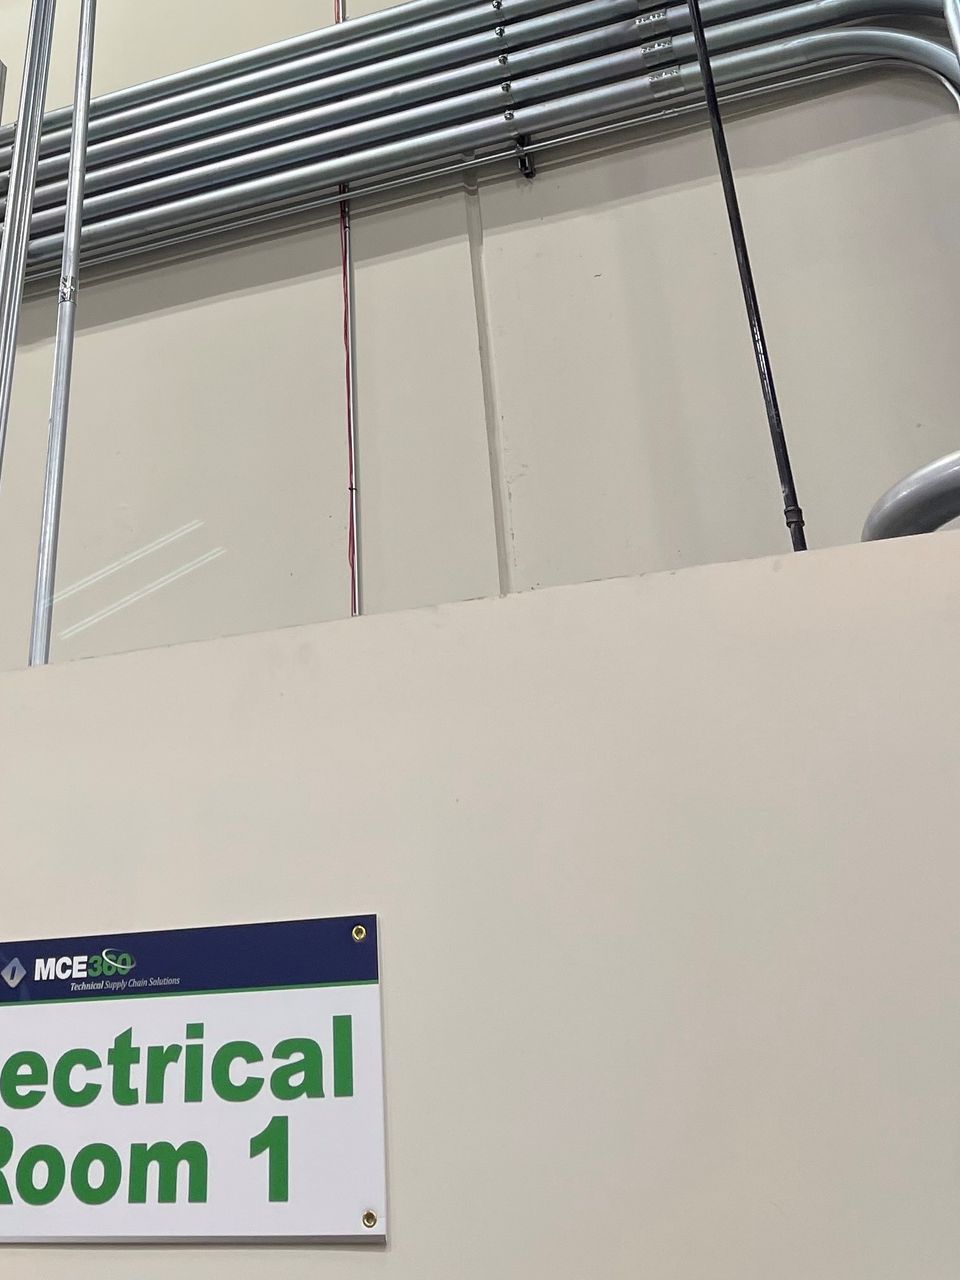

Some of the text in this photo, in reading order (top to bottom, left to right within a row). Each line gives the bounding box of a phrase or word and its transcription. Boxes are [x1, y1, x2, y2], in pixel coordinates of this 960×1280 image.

[34, 954, 132, 981] MCE360
[70, 976, 180, 993] Technical Supply Chain Solutions
[250, 1115, 289, 1202] 1
